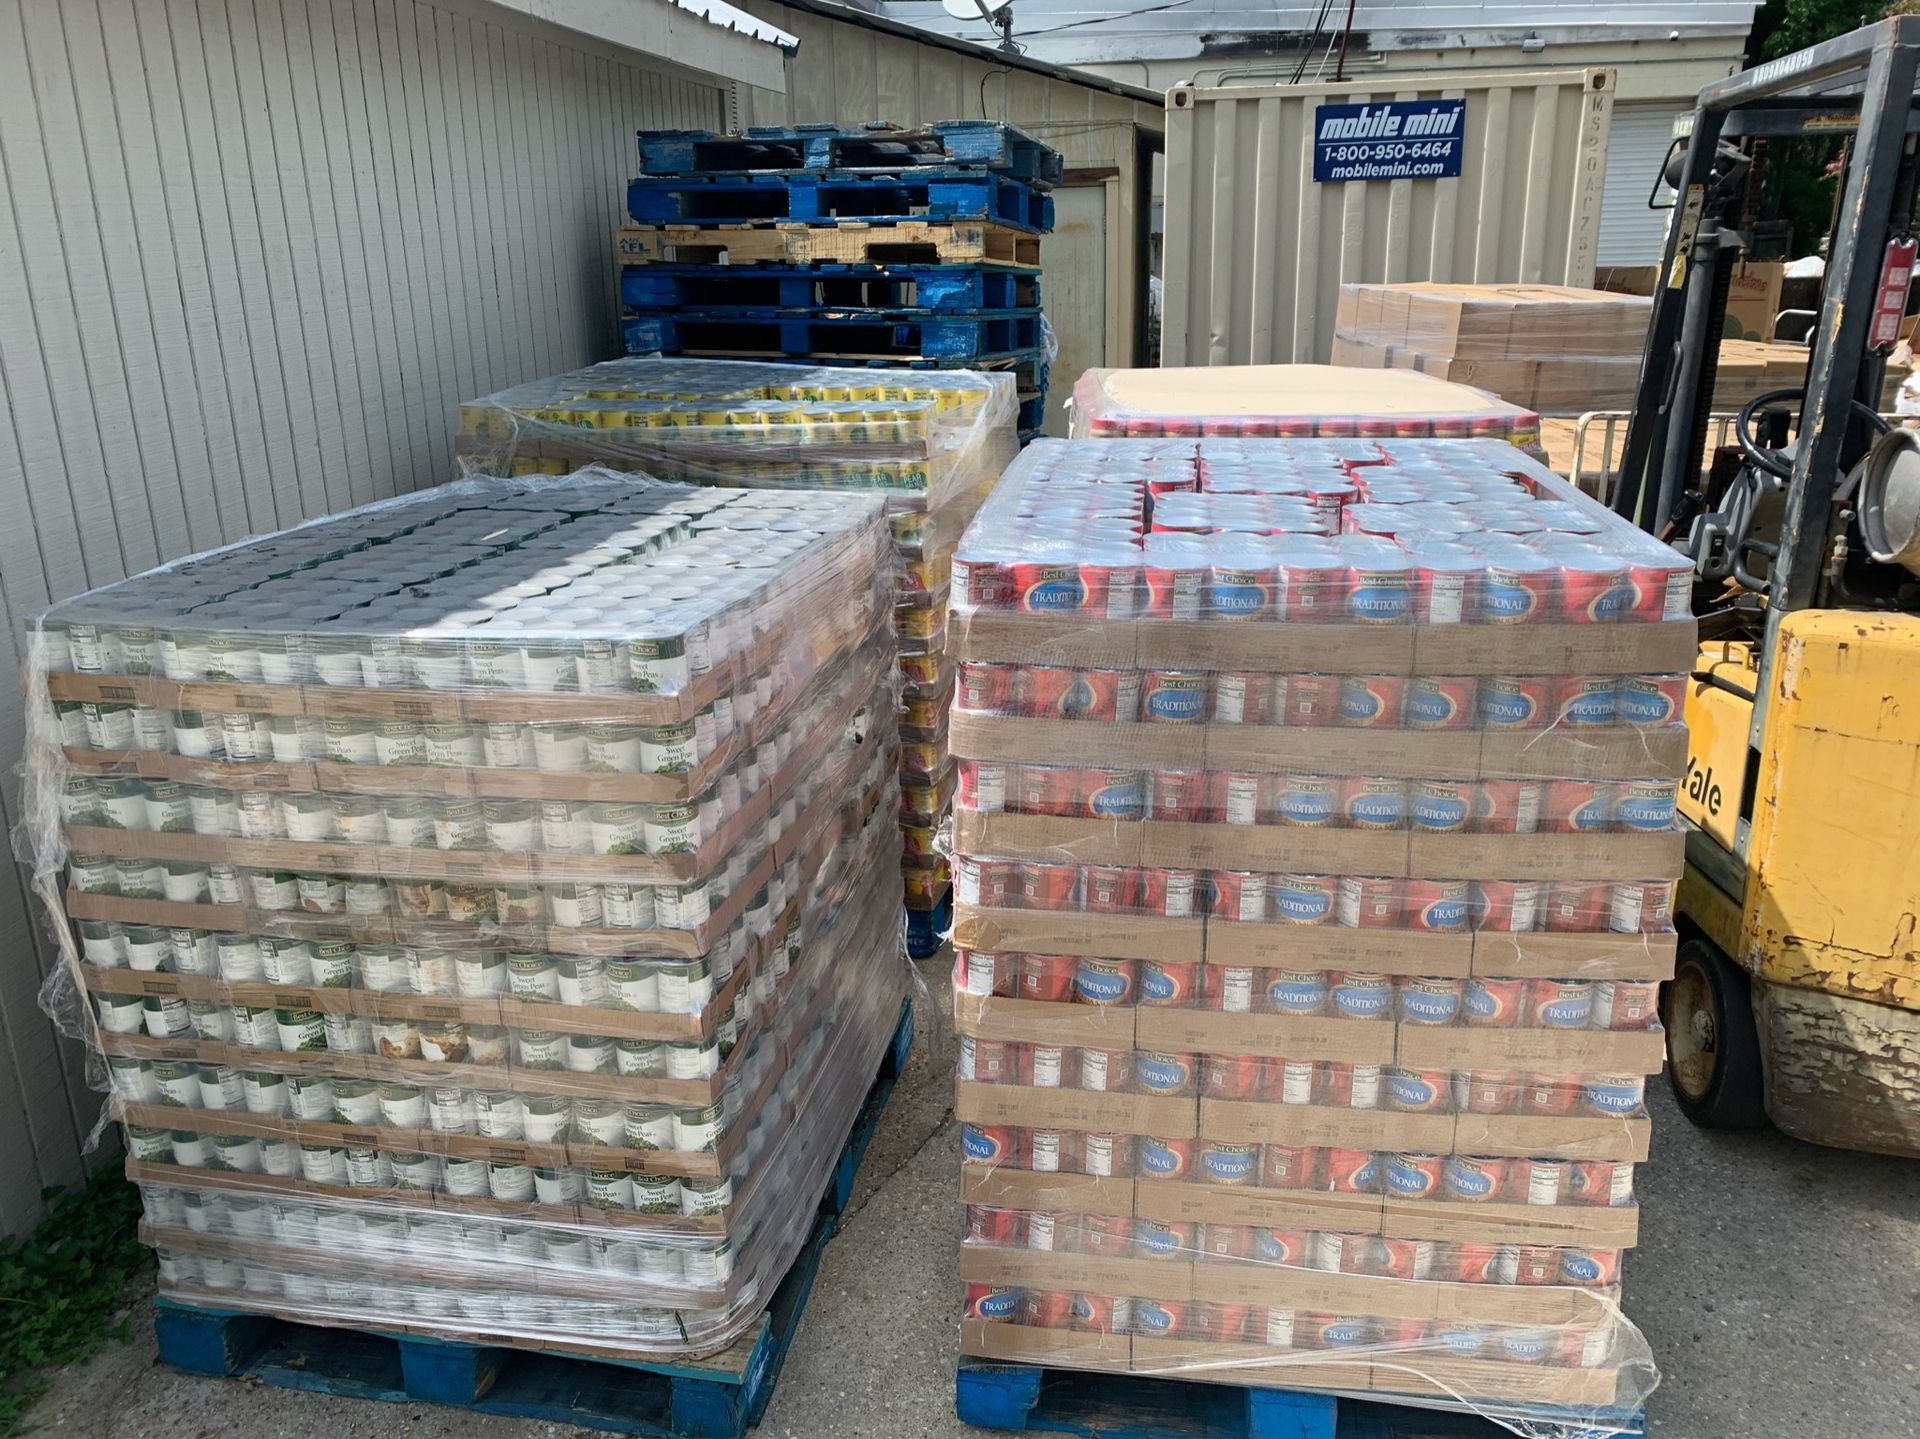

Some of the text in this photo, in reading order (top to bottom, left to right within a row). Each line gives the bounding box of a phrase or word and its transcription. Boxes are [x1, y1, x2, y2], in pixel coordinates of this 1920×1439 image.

[1319, 106, 1460, 140] mobile mini
[1324, 142, 1452, 161] 1-800-950-6464
[1330, 161, 1444, 178] mobilemini.com
[1160, 679, 1175, 688] Best
[665, 747, 686, 755] Sweet
[658, 755, 677, 763] Green
[667, 827, 687, 835] Sweet
[659, 834, 680, 843] Green
[1293, 882, 1320, 892] Choice
[331, 960, 350, 969] Sweet
[1090, 963, 1117, 975] Choice
[1280, 973, 1295, 981] Best
[1343, 976, 1358, 985] Best
[1424, 984, 1452, 993] Choice
[646, 1189, 666, 1197] Sweet
[640, 1195, 659, 1203] Green
